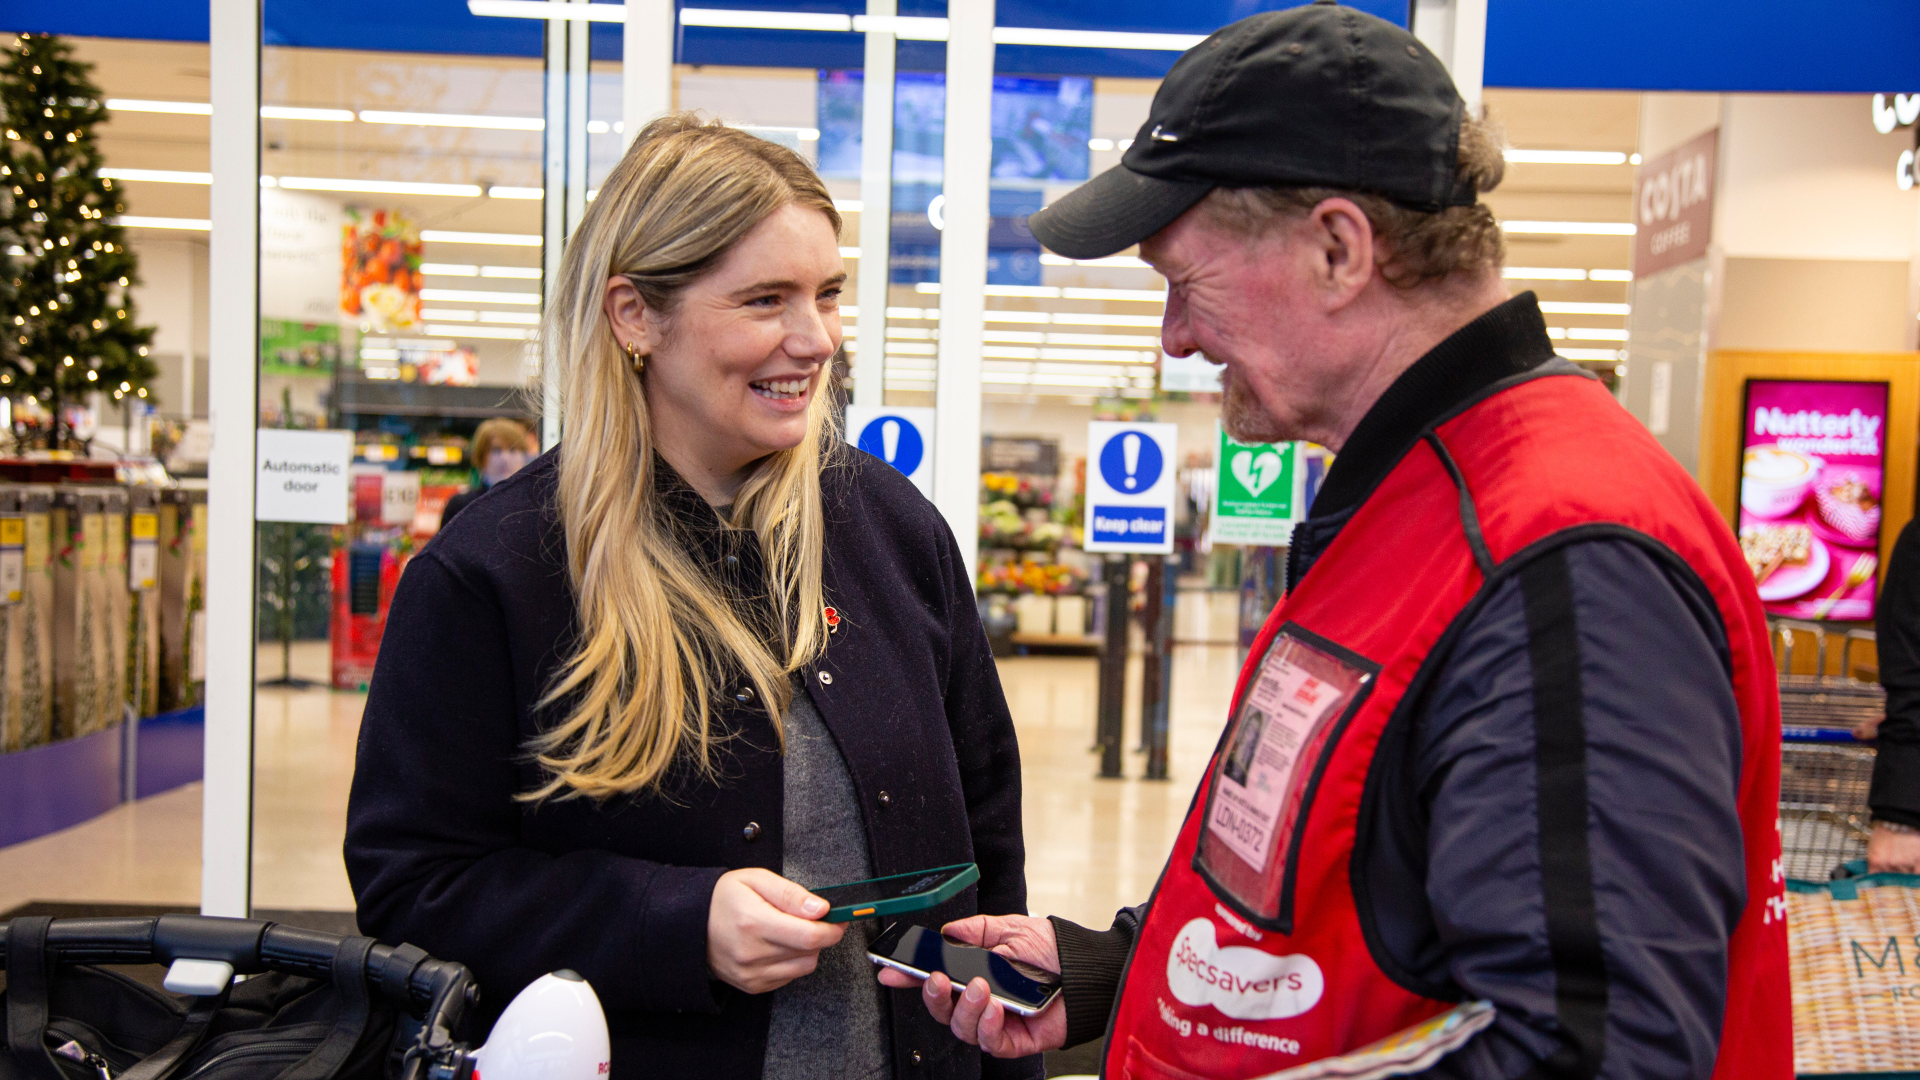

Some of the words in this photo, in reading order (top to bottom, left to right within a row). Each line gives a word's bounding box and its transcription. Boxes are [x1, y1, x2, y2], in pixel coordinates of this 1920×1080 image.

[1641, 154, 1707, 226] COSTA
[1650, 221, 1690, 255] COFFEE
[1754, 406, 1881, 438] Nutterly
[263, 459, 341, 475] Automatic
[283, 479, 317, 493] door
[1095, 515, 1129, 536] Keep
[1130, 516, 1165, 534] clear
[1216, 801, 1265, 853] LDN-0372
[1176, 936, 1303, 995] Specsavers
[1850, 934, 1920, 978] M
[1196, 1022, 1209, 1037] a
[1213, 1026, 1301, 1055] difference
